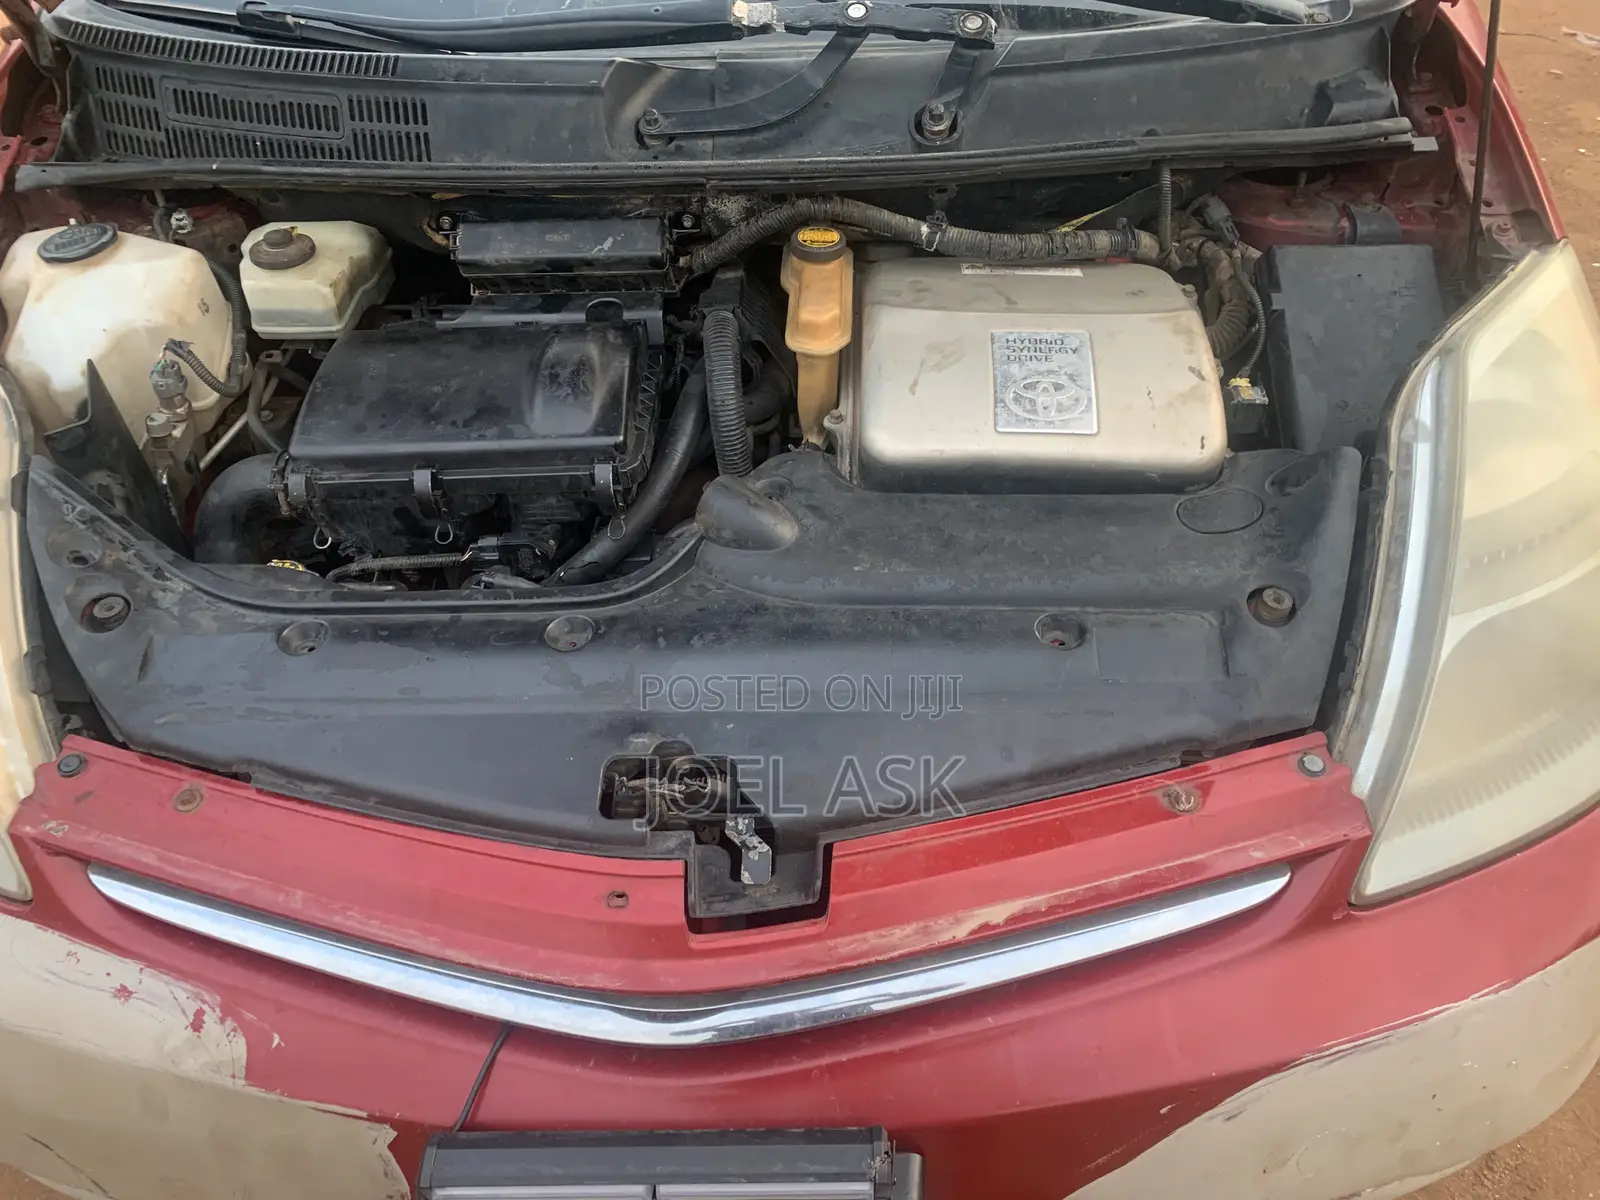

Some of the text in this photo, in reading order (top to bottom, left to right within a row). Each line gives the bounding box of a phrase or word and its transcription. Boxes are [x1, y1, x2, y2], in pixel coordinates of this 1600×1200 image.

[1005, 337, 1065, 346] HYBRID
[1005, 345, 1079, 355] SYNERGY
[1007, 354, 1054, 362] DRIVE
